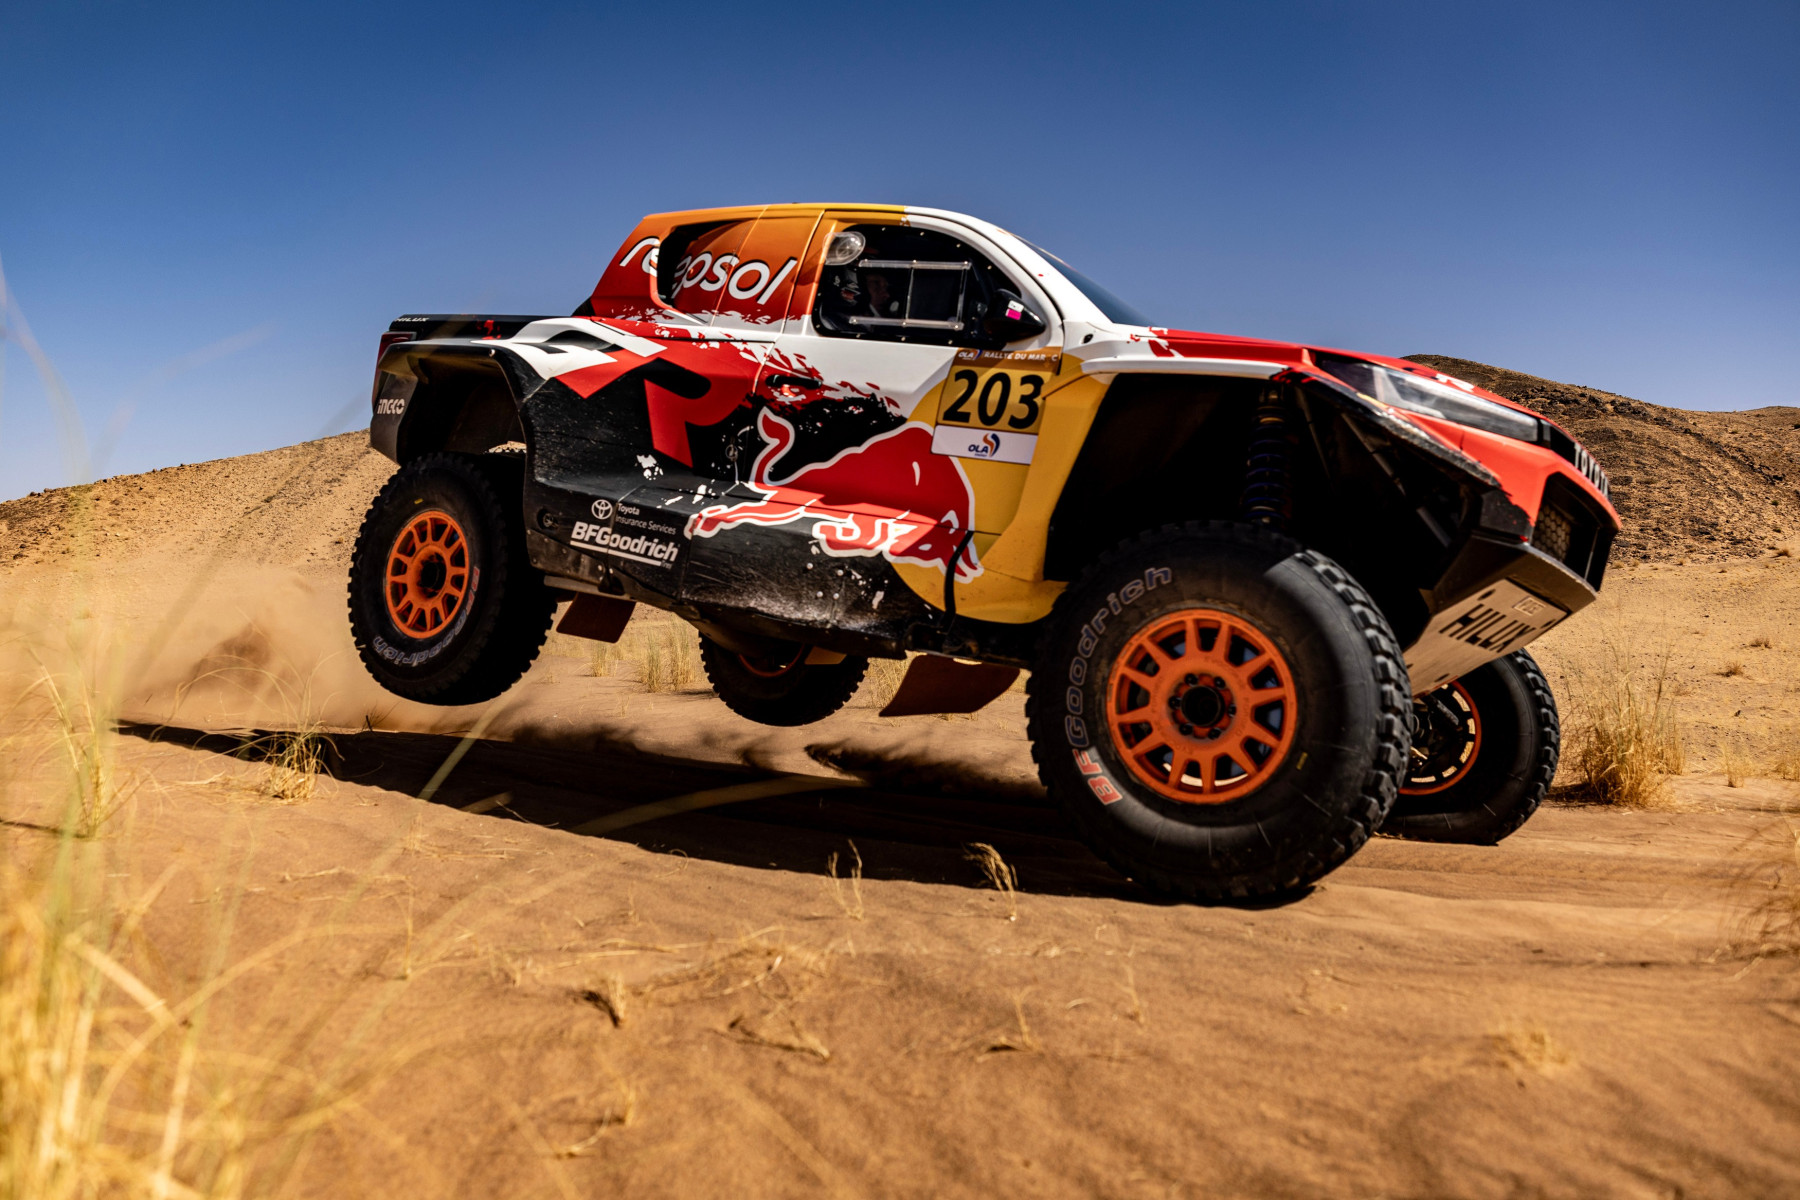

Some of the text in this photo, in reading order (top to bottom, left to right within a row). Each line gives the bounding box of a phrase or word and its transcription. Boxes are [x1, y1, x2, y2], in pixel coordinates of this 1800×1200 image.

[619, 236, 798, 306] repsol
[984, 351, 1013, 360] RALLYE
[1027, 354, 1058, 362] MARC
[942, 369, 1045, 430] 203
[968, 444, 989, 454] OLA
[615, 514, 677, 535] Insurance Services
[617, 502, 640, 515] Toyota
[571, 521, 679, 562] BFGoodrich
[1438, 603, 1537, 653] HILUX
[1065, 567, 1172, 805] BFGoodrich
